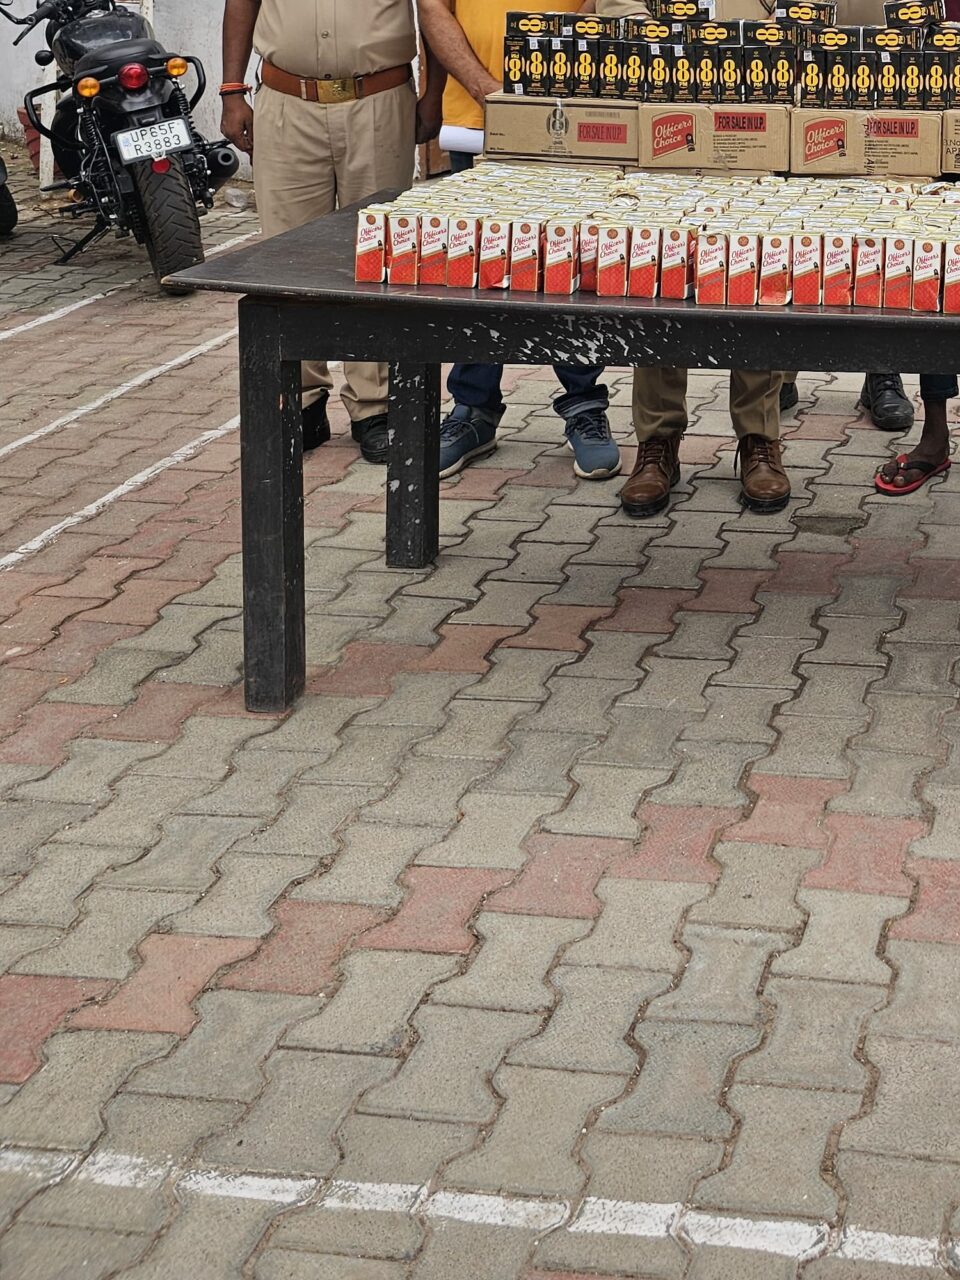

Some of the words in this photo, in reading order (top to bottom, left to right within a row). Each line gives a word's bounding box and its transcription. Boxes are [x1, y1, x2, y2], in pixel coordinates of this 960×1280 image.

[719, 116, 731, 129] FOR
[732, 116, 746, 130] SALE
[130, 122, 176, 143] UP65F
[869, 121, 881, 134] FOR
[882, 122, 898, 134] SALE
[899, 122, 904, 134] IN
[906, 122, 917, 135] U.P.
[807, 123, 844, 143] Officer's
[133, 134, 181, 156] R3883
[653, 134, 682, 149] Choice
[805, 139, 834, 155] Choice
[359, 234, 376, 243] Choice
[393, 237, 410, 246] Choice
[423, 237, 440, 246] Choice
[449, 240, 467, 249] Choice
[482, 244, 499, 252] Choice
[513, 244, 530, 252] Choice
[548, 246, 566, 255] Choice
[600, 249, 618, 258] Choice
[632, 249, 649, 258] Choice
[664, 251, 680, 259] Choice
[700, 256, 717, 265] Choice
[730, 256, 748, 266] Choice
[762, 258, 781, 267] Choice
[794, 257, 812, 266] Choice
[826, 258, 843, 267] Choice
[859, 258, 875, 267] Choice
[887, 260, 904, 269] Choice
[915, 263, 932, 272] Choice
